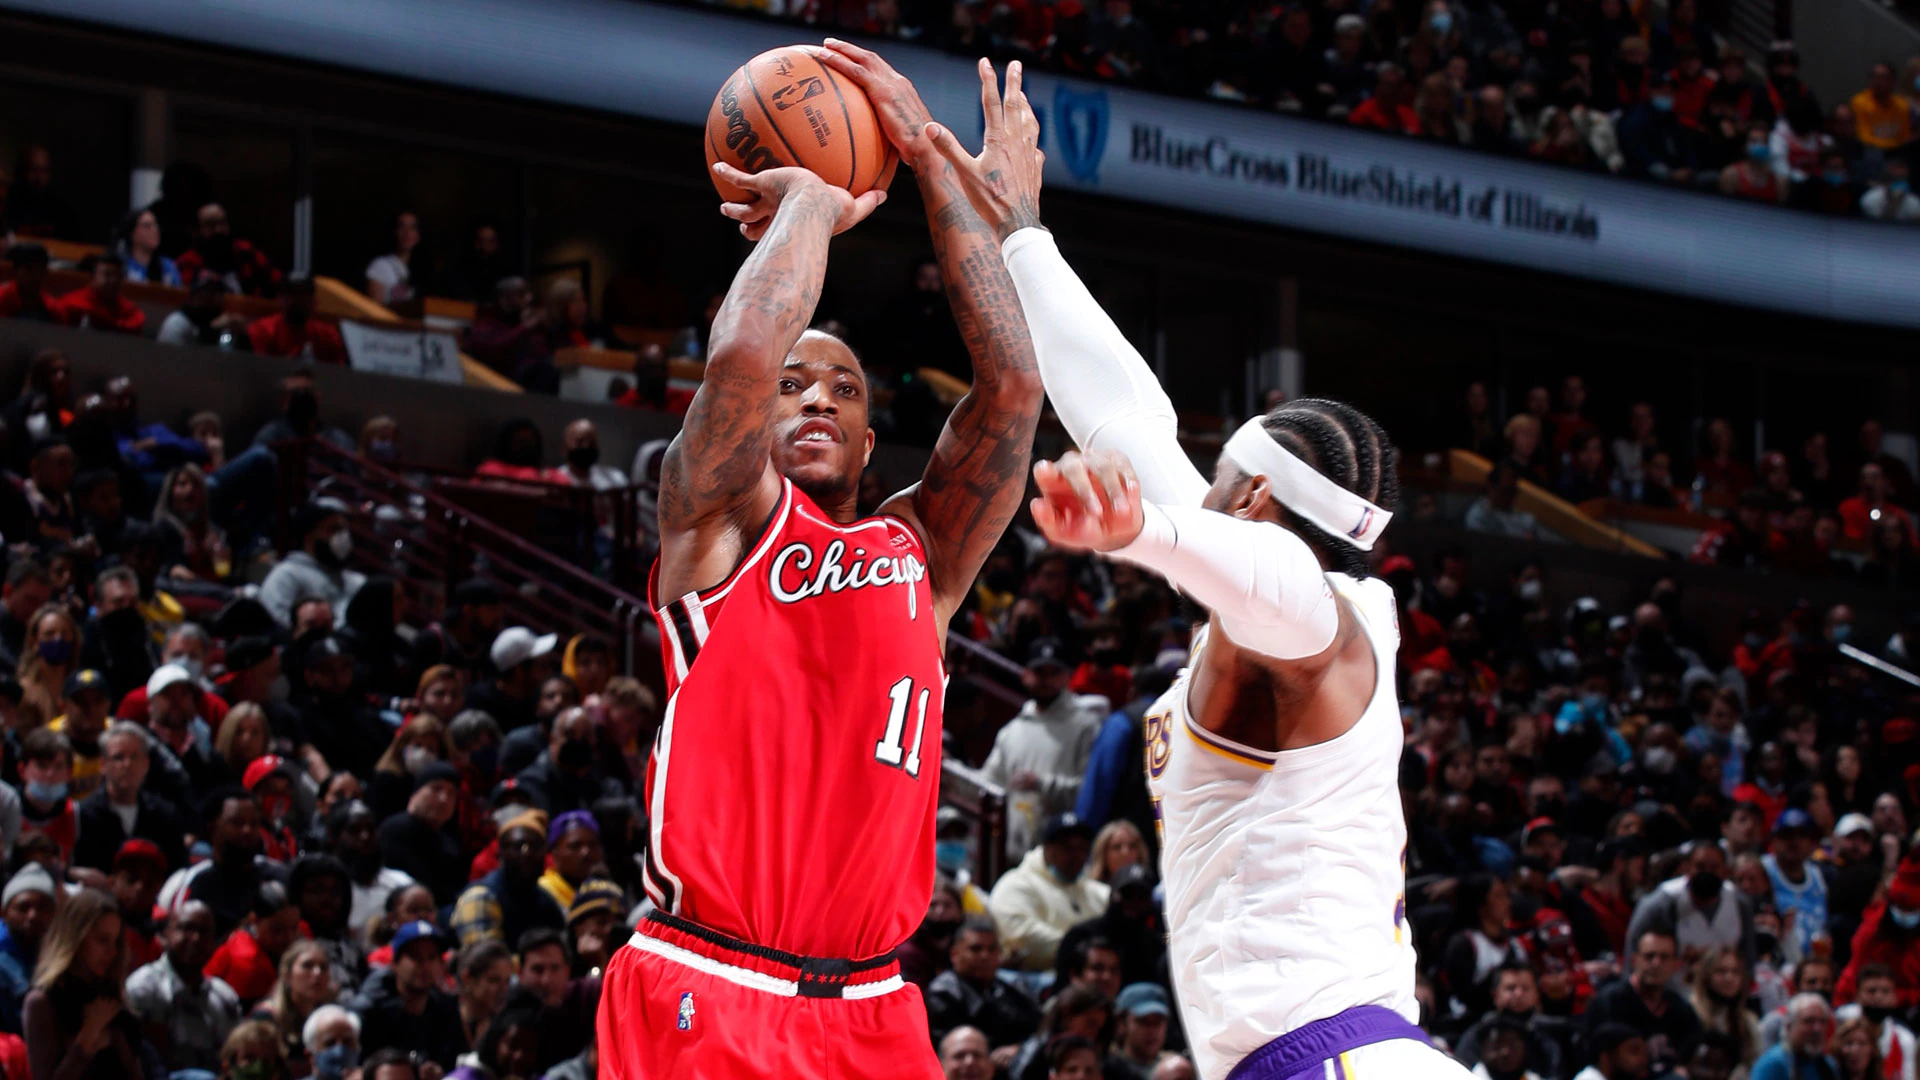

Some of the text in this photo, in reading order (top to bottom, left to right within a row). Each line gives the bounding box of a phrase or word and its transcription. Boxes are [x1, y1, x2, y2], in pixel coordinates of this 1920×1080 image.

[1130, 122, 1600, 240] BlueCross BlueShield of Illinois
[874, 675, 930, 780] 11
